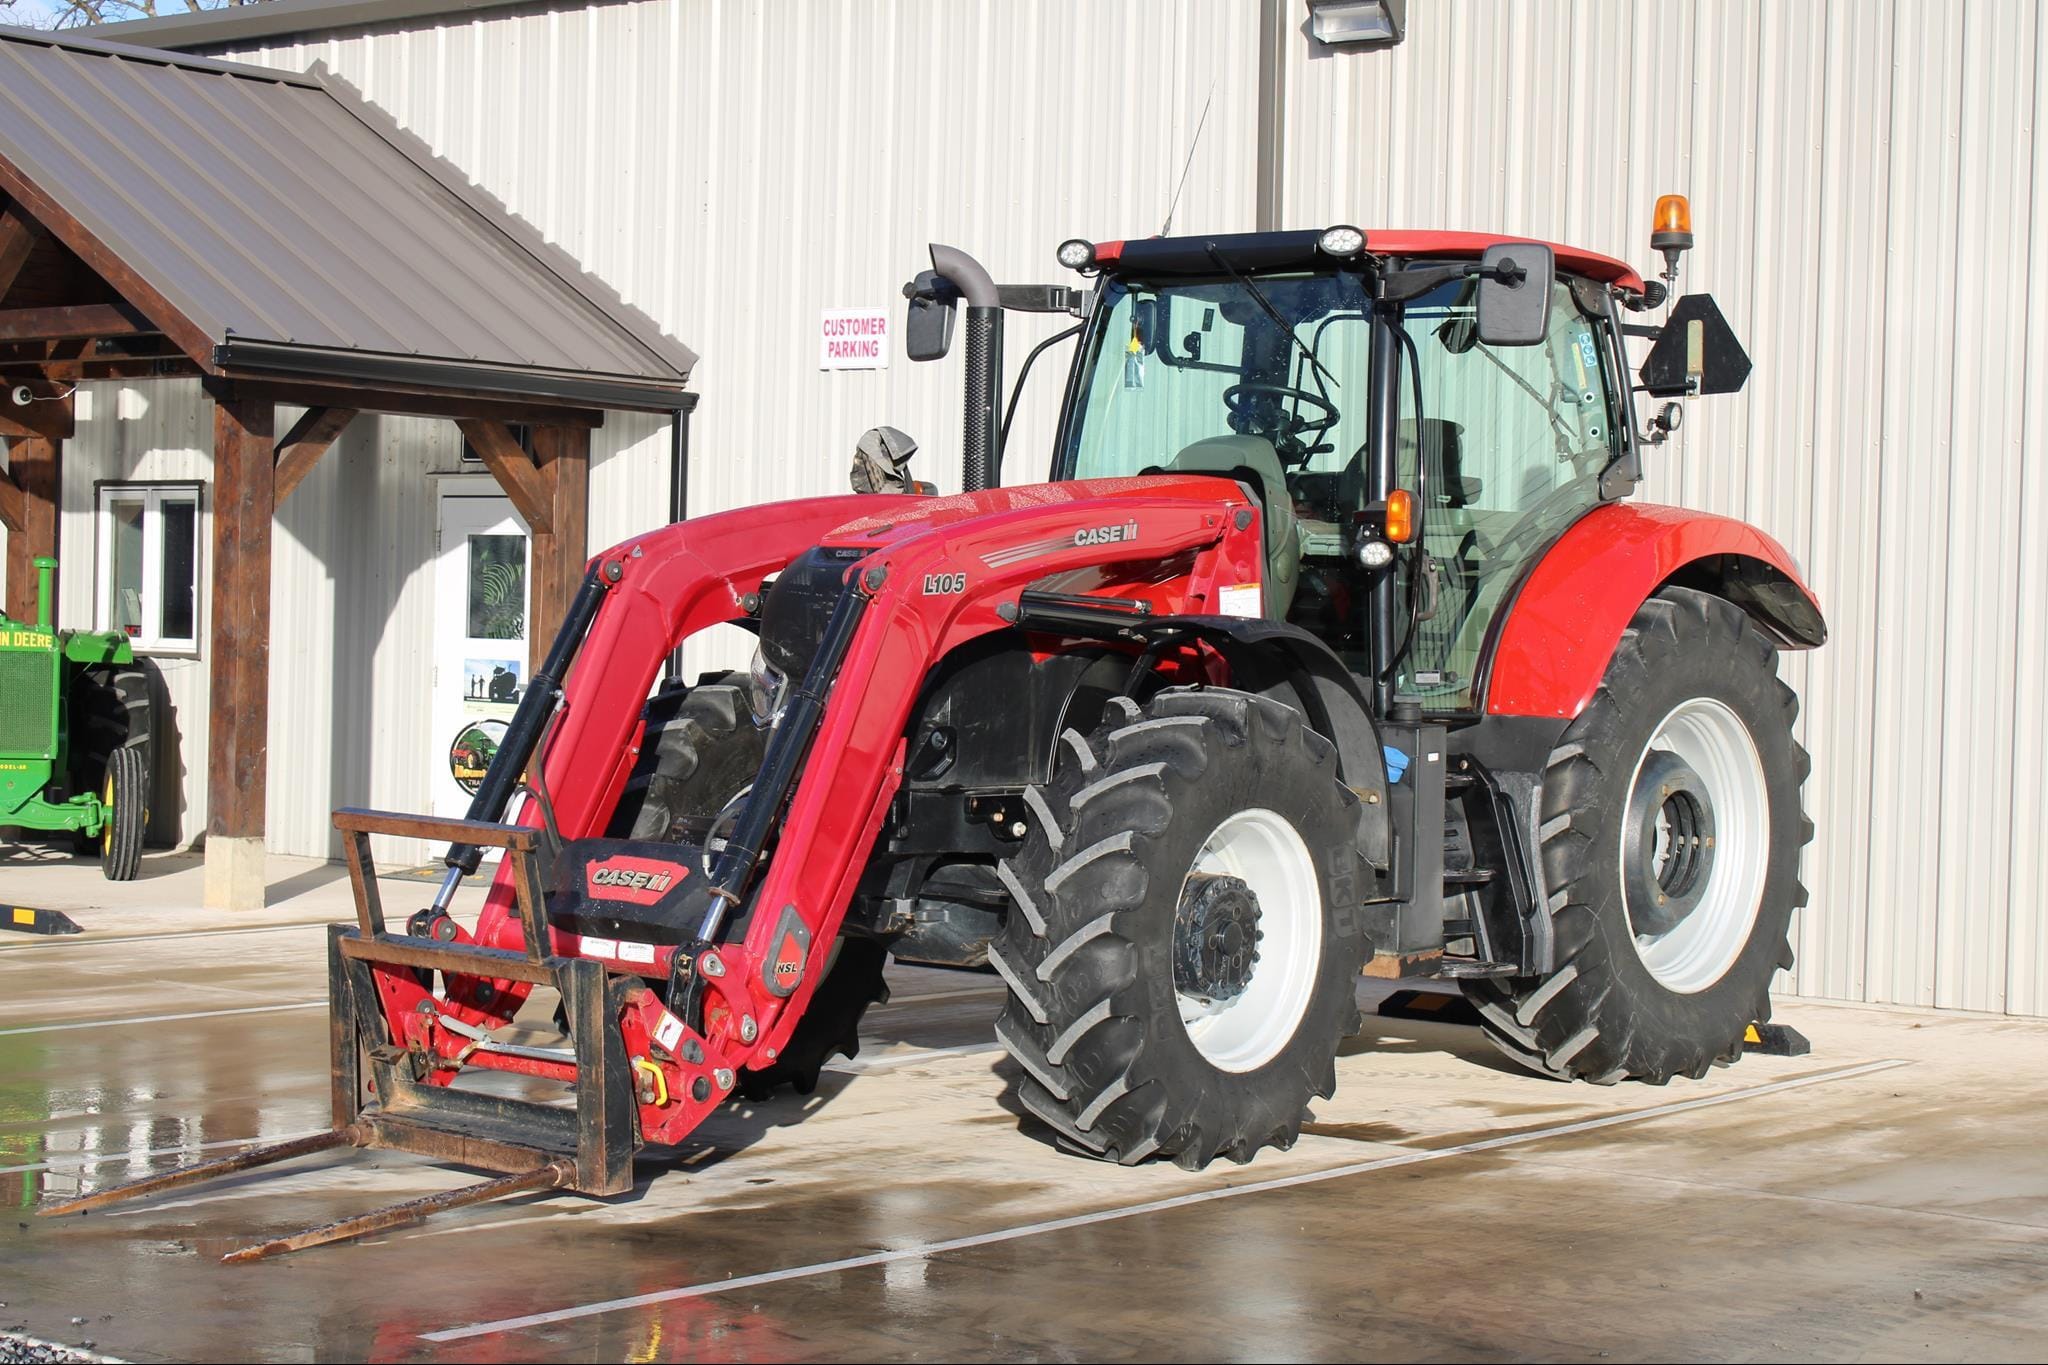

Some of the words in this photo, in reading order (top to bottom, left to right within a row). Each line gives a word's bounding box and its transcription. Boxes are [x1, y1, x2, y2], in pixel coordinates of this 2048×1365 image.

[823, 318, 886, 336] CUSTOMER
[828, 340, 879, 358] PARKING
[1074, 526, 1122, 547] CASE
[836, 550, 859, 558] CASE
[922, 573, 966, 596] L105
[14, 632, 53, 648] DEERE
[592, 868, 650, 888] CASE
[777, 962, 798, 974] NSL
